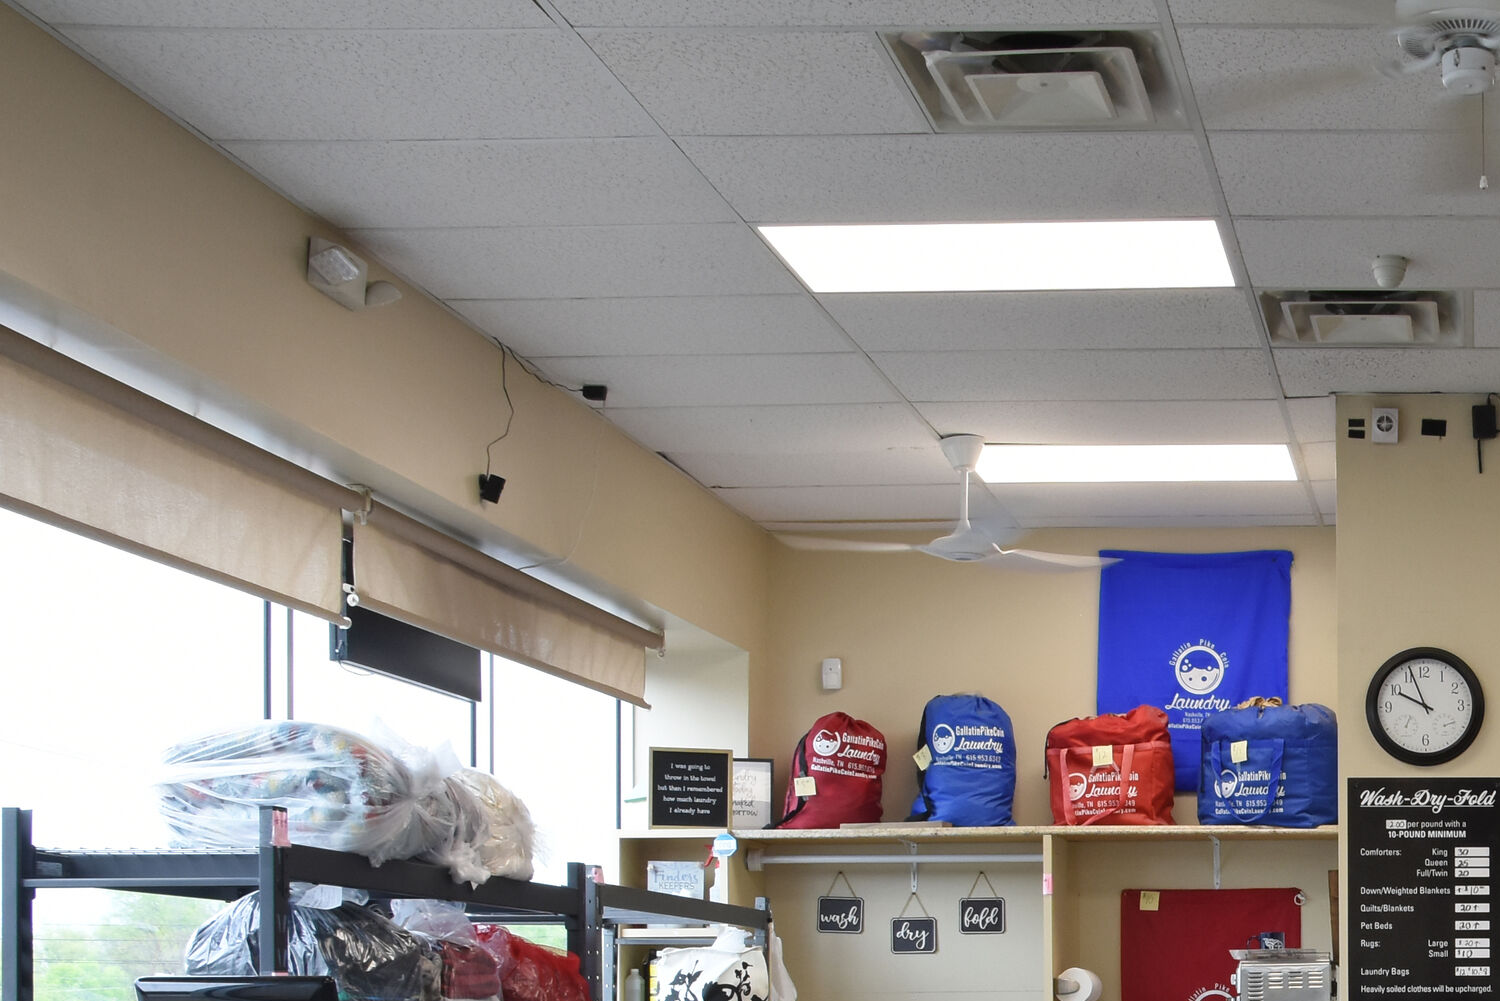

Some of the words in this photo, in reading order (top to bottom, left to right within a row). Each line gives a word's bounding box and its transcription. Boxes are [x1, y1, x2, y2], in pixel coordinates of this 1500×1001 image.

[1419, 666, 1430, 678] 12
[1440, 671, 1444, 682] 1
[1391, 684, 1401, 695] 10
[1451, 682, 1458, 694] 2
[1165, 693, 1231, 712] Laundry
[1384, 702, 1392, 713] 9
[1457, 700, 1465, 711] 3
[954, 737, 1003, 754] Laundry
[1422, 734, 1429, 746] 6
[837, 744, 880, 765] Laundry
[1360, 788, 1496, 814] Wash-Dry-Fold
[1407, 821, 1419, 829] per
[1420, 820, 1444, 829] pound
[1360, 848, 1402, 856] Comforters:
[1432, 848, 1448, 857] King
[1425, 858, 1448, 867] Queen
[1417, 869, 1449, 877] Full/Twin
[658, 882, 695, 890] KEEPERS
[1361, 886, 1419, 896] Down/Weighted
[1420, 886, 1450, 896] Blankets
[1360, 904, 1415, 913] Quilts/Blankets
[821, 906, 860, 929] wash
[964, 906, 999, 930] fold
[896, 922, 929, 950] dry
[1361, 939, 1380, 948] Rugs:
[1428, 940, 1448, 948] Large
[1429, 950, 1448, 958] Small
[1360, 968, 1389, 976] Laundry
[1391, 967, 1409, 976] Bags
[1361, 985, 1385, 994] Heavily
[1386, 985, 1406, 993] soiled
[1455, 985, 1492, 994] upcharged.
